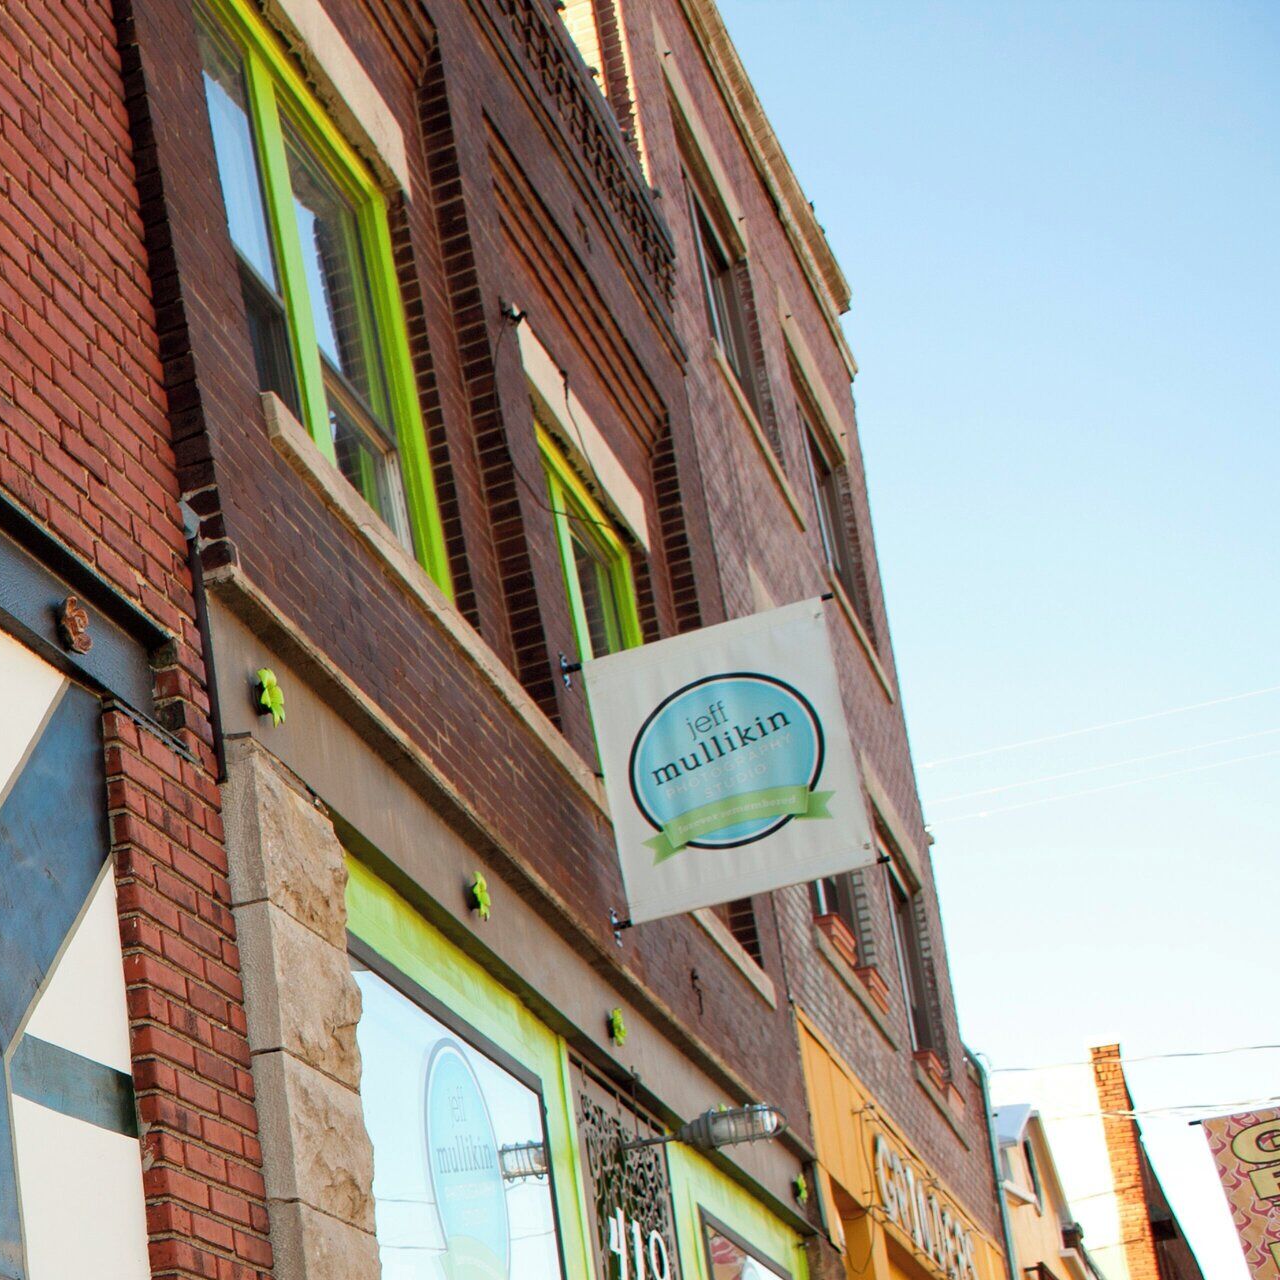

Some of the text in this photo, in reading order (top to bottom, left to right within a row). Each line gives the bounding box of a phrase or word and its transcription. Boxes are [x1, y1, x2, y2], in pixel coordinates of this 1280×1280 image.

[685, 700, 729, 741] jeff
[651, 710, 791, 786] mullikin
[666, 732, 793, 800] PHOTOGRAPHY
[704, 764, 768, 799] STUDIO
[447, 1086, 467, 1128] jeff
[437, 1135, 494, 1174] mullikin
